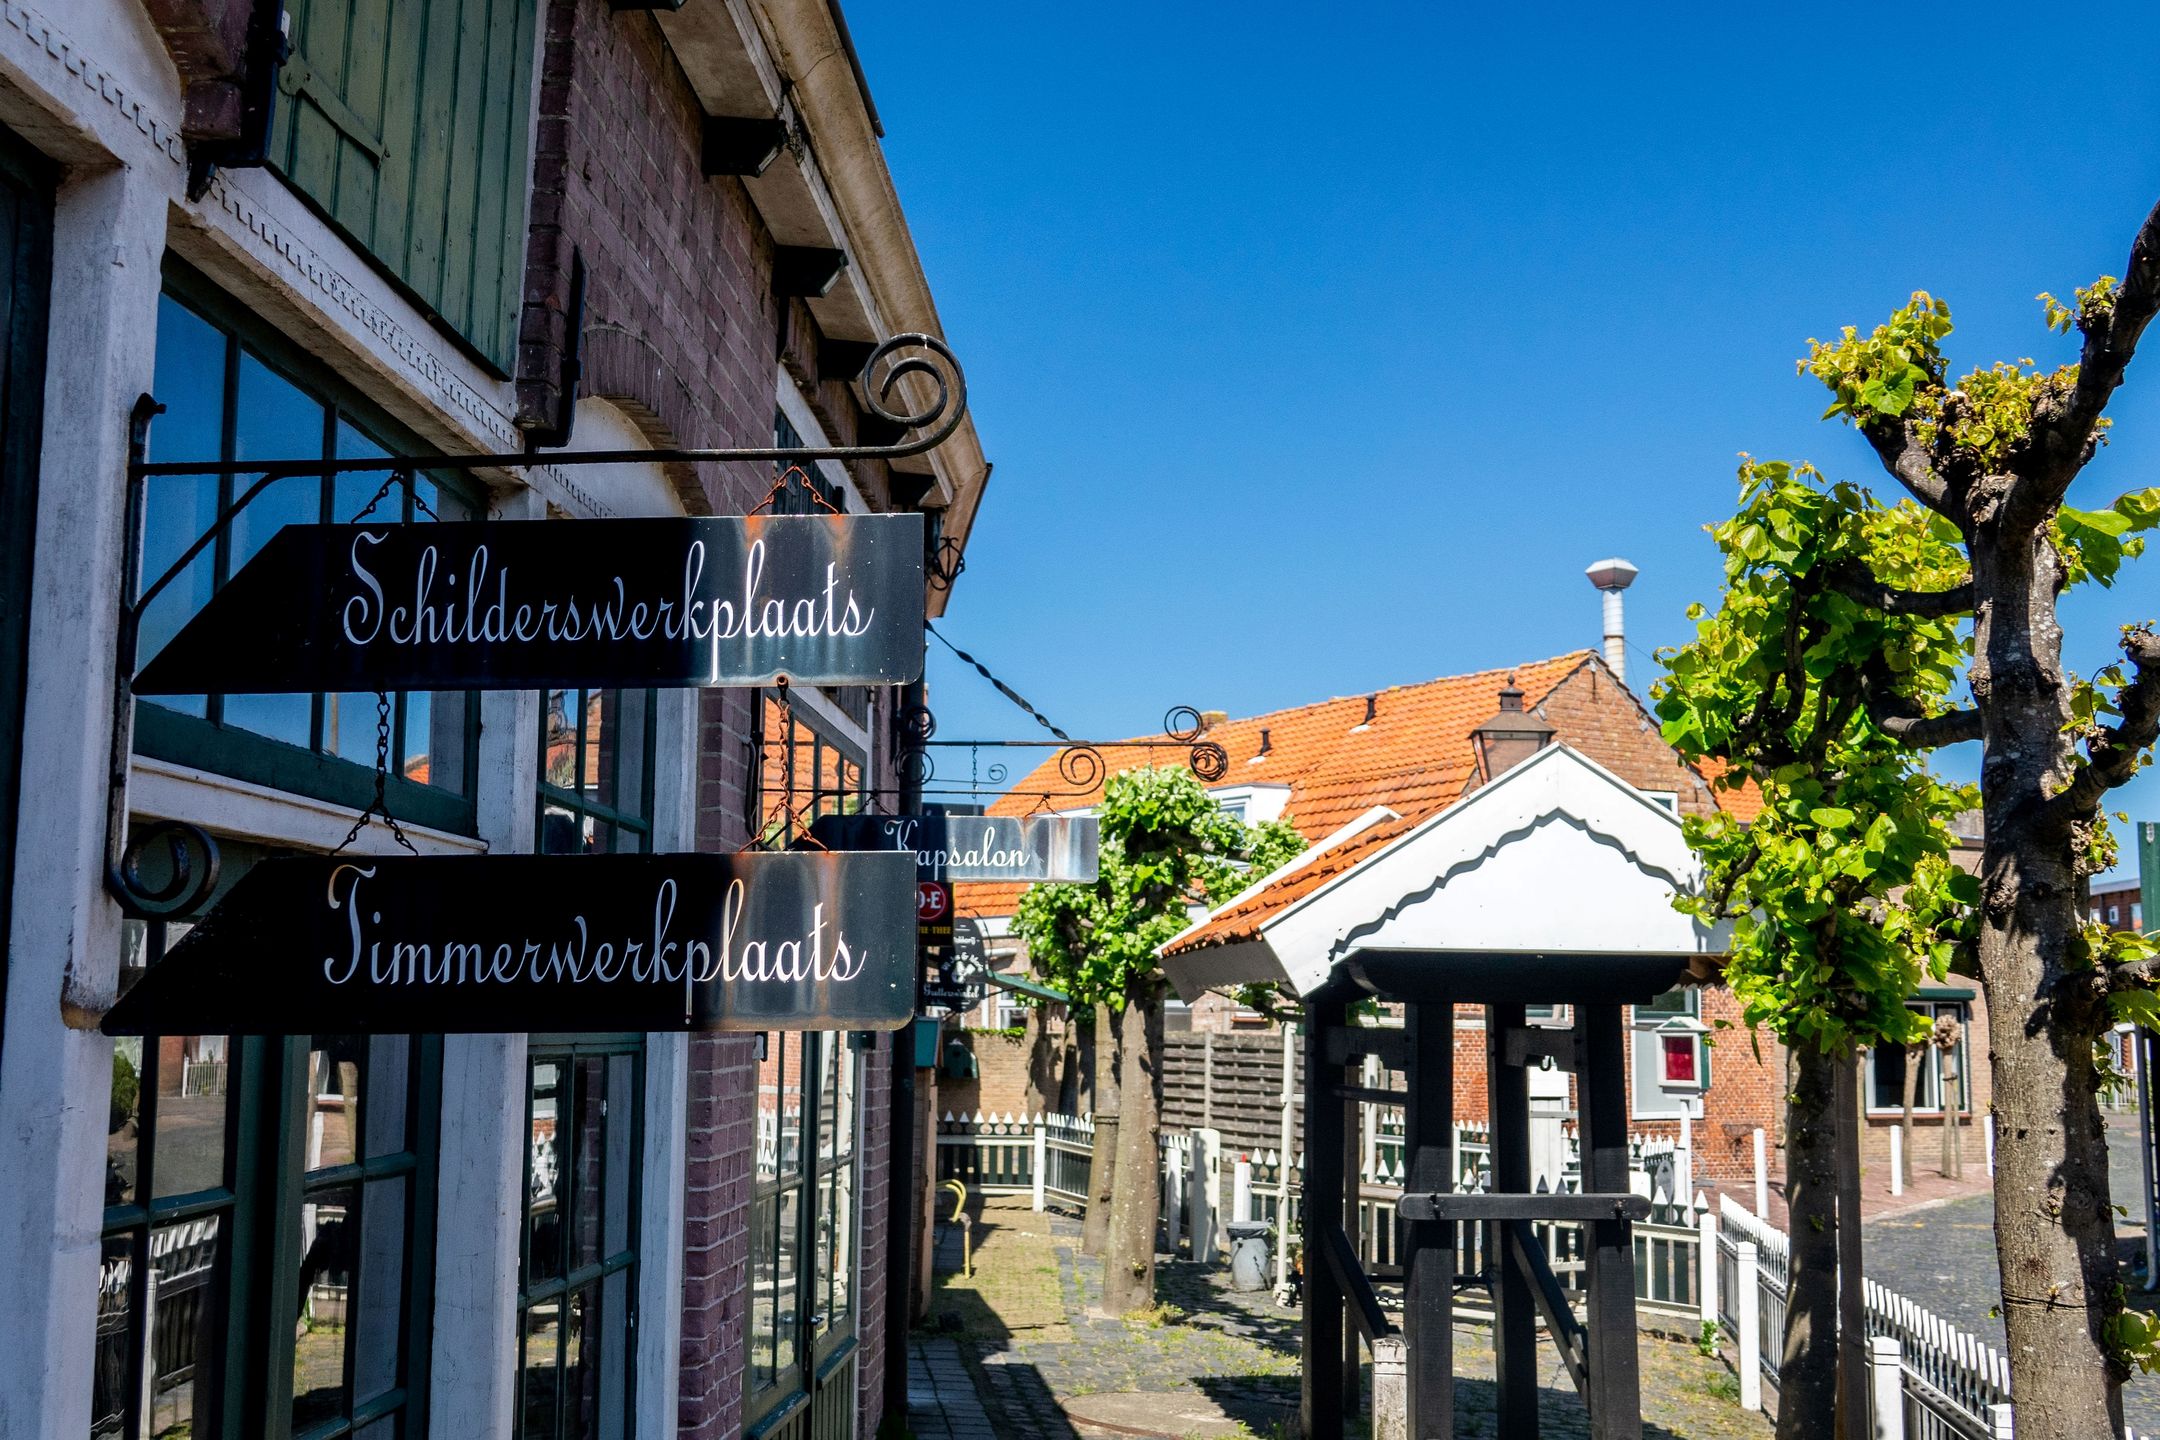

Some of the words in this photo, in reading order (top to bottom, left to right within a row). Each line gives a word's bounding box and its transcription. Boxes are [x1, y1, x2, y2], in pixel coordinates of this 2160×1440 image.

[342, 531, 875, 683] Schilderswerkplaats
[884, 819, 1031, 881] Kapsalon
[324, 864, 867, 1025] Timmerwerkplaats
